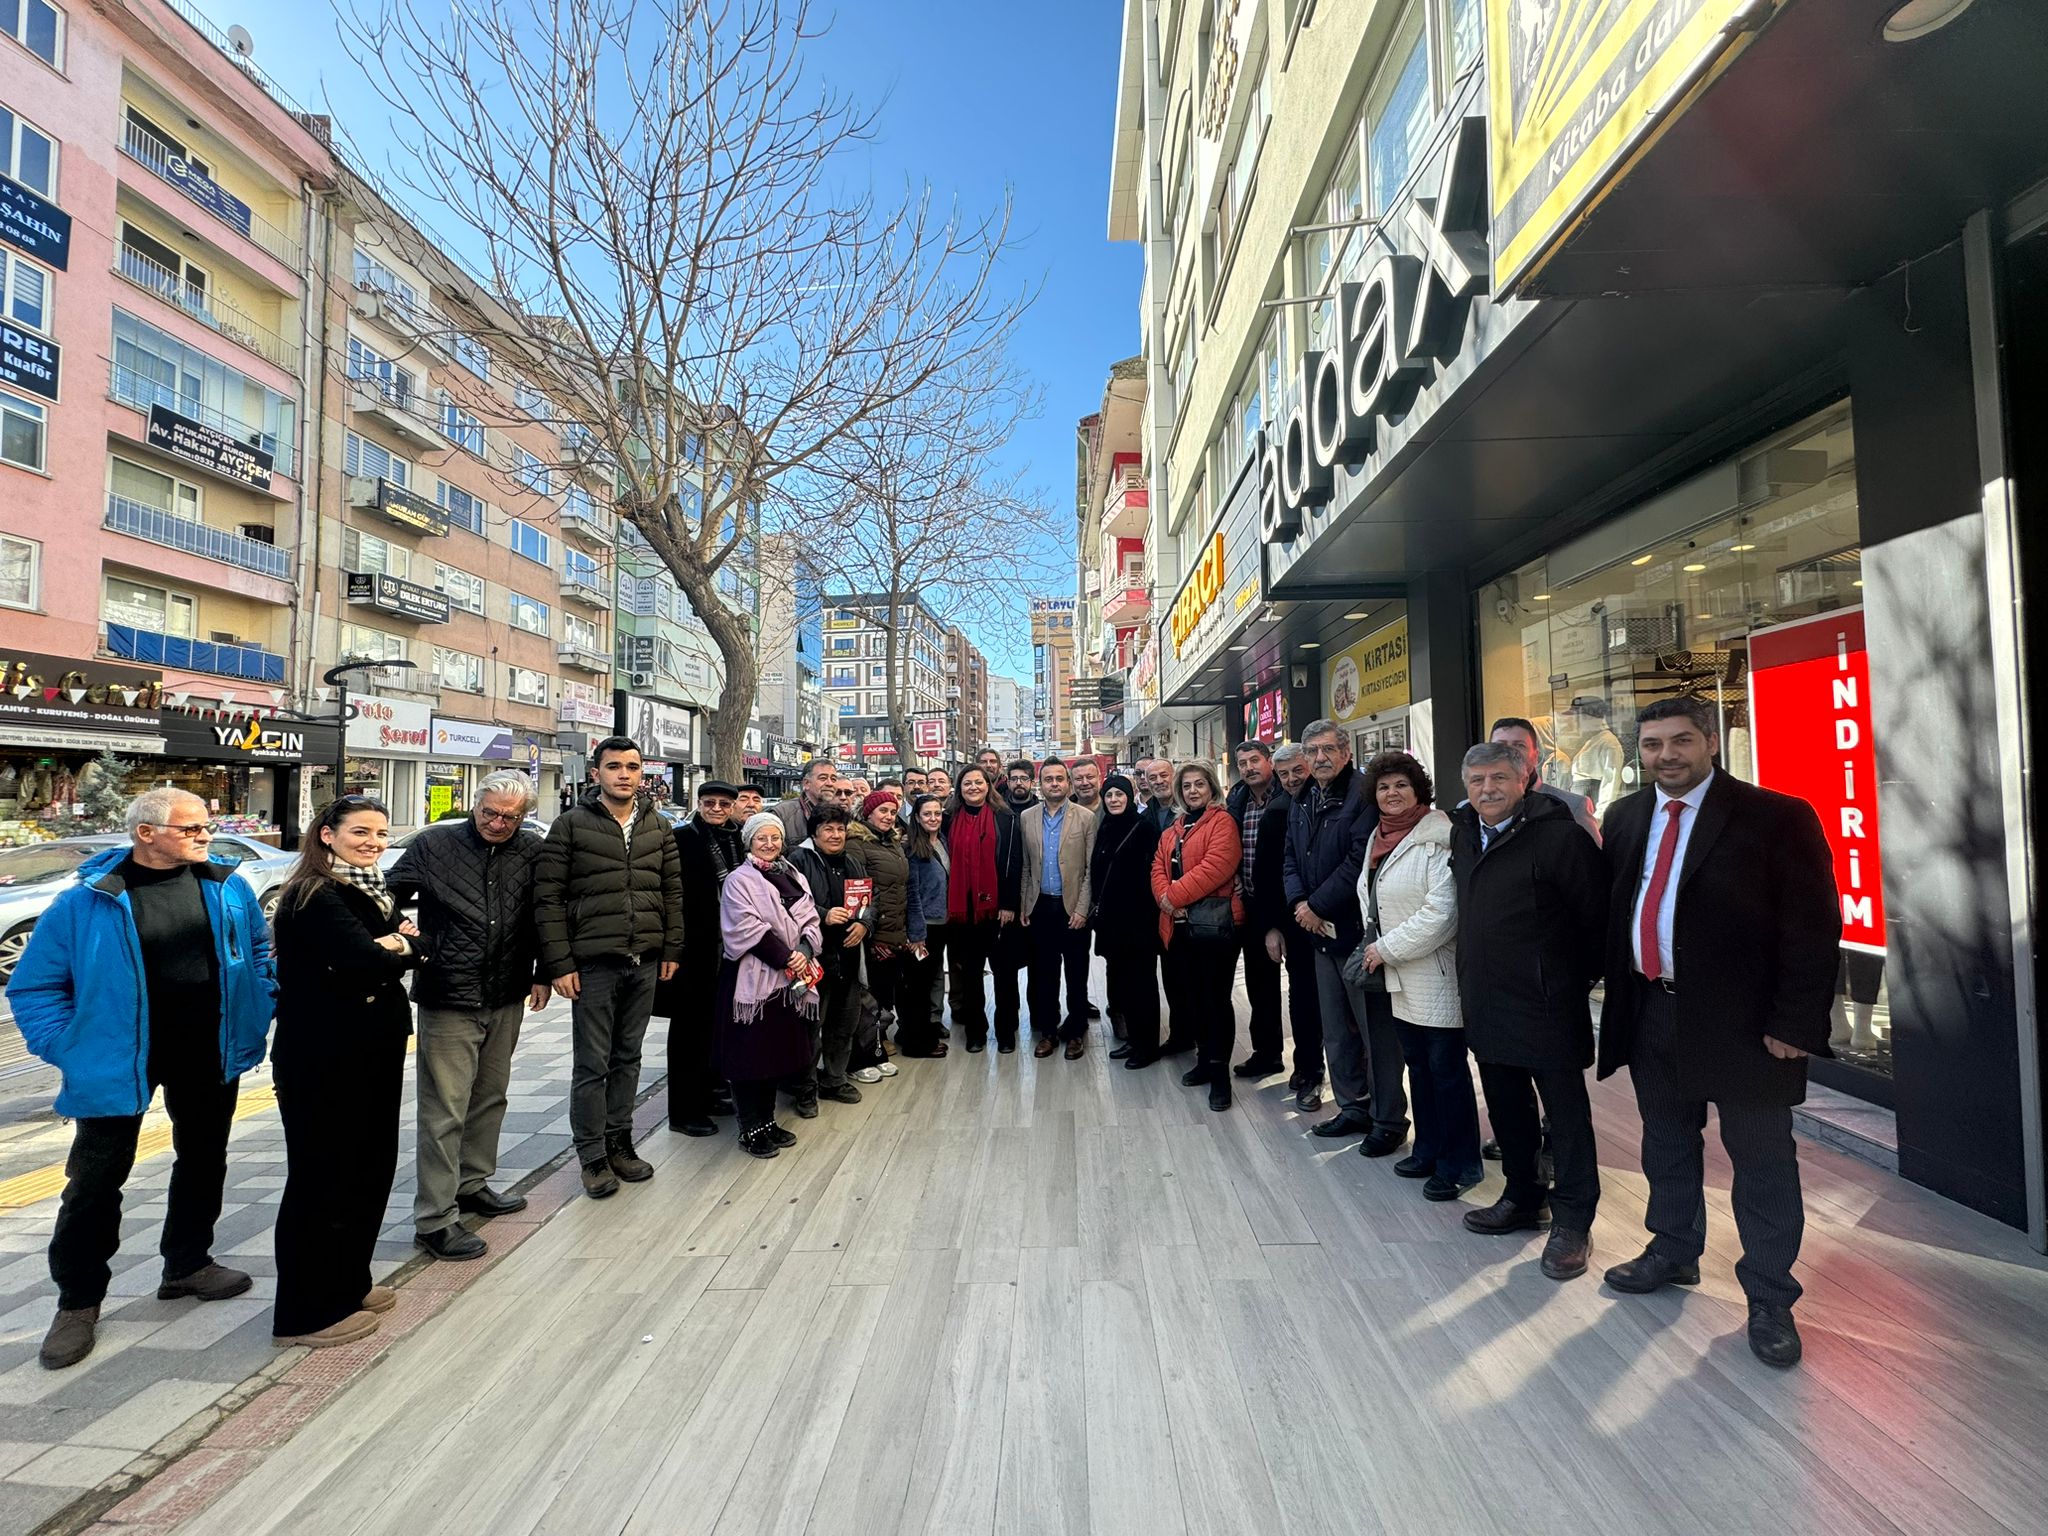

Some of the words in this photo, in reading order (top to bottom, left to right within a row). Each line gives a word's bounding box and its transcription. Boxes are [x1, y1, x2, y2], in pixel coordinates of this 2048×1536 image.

[0, 202, 63, 244] ŞAHİN
[0, 325, 53, 363] REL
[1260, 116, 1488, 545] addax
[4, 351, 52, 380] Kuaför
[174, 423, 220, 449] AVUKATLIK
[199, 426, 235, 446] AYÇİÇEK
[216, 463, 232, 475] 355
[219, 452, 272, 481] AYÇİÇEK
[1171, 533, 1223, 662] ÇIRACI
[59, 671, 163, 710] Cemil
[36, 708, 89, 719] KURUYEMİŞ
[94, 713, 123, 722] DOĞAL
[123, 715, 160, 725] ÜRÜNLER
[379, 725, 429, 747] Şeref
[450, 733, 481, 744] TURKCELL
[922, 725, 938, 745] E
[1832, 631, 1874, 929] İNDİRİM
